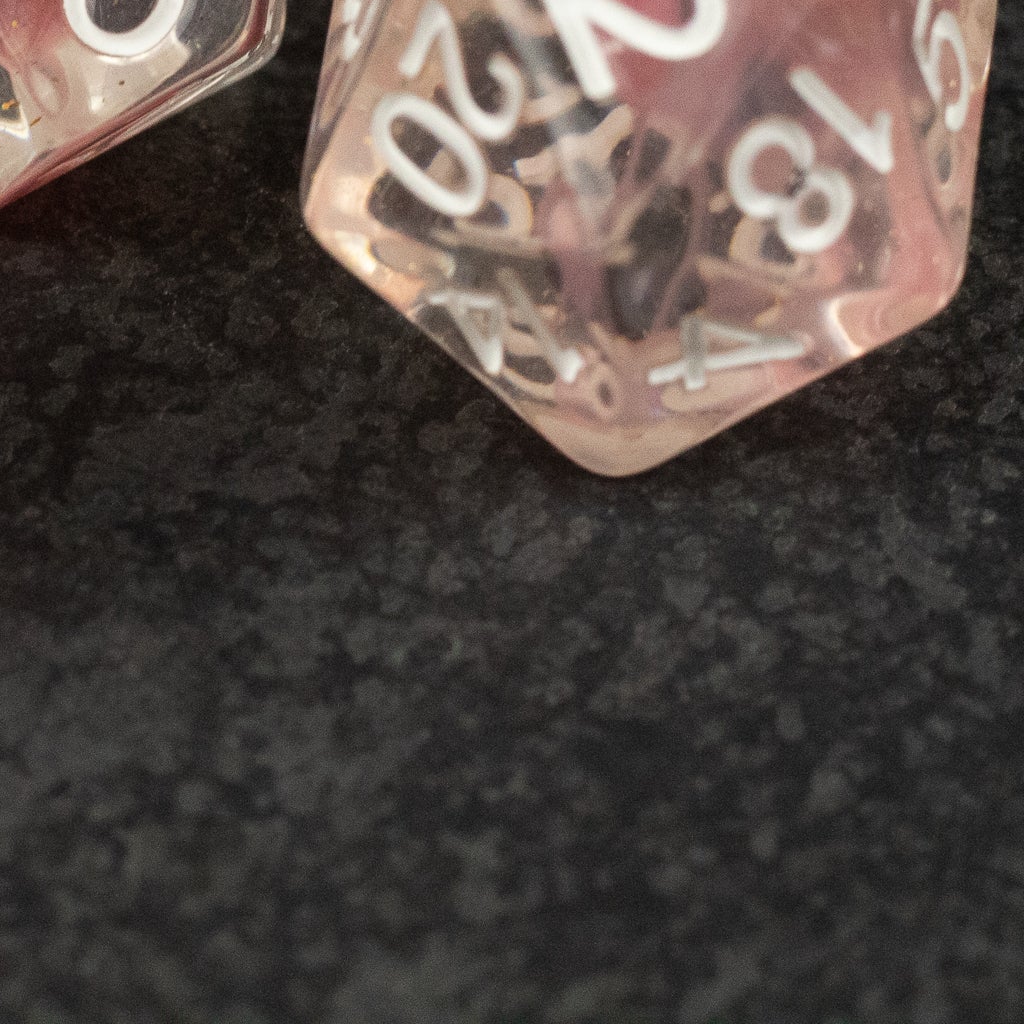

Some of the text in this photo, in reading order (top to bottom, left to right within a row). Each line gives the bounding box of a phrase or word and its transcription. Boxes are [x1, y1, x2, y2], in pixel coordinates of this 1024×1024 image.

[372, 0, 524, 217] 20
[729, 66, 894, 253] 18
[649, 317, 808, 390] 4
